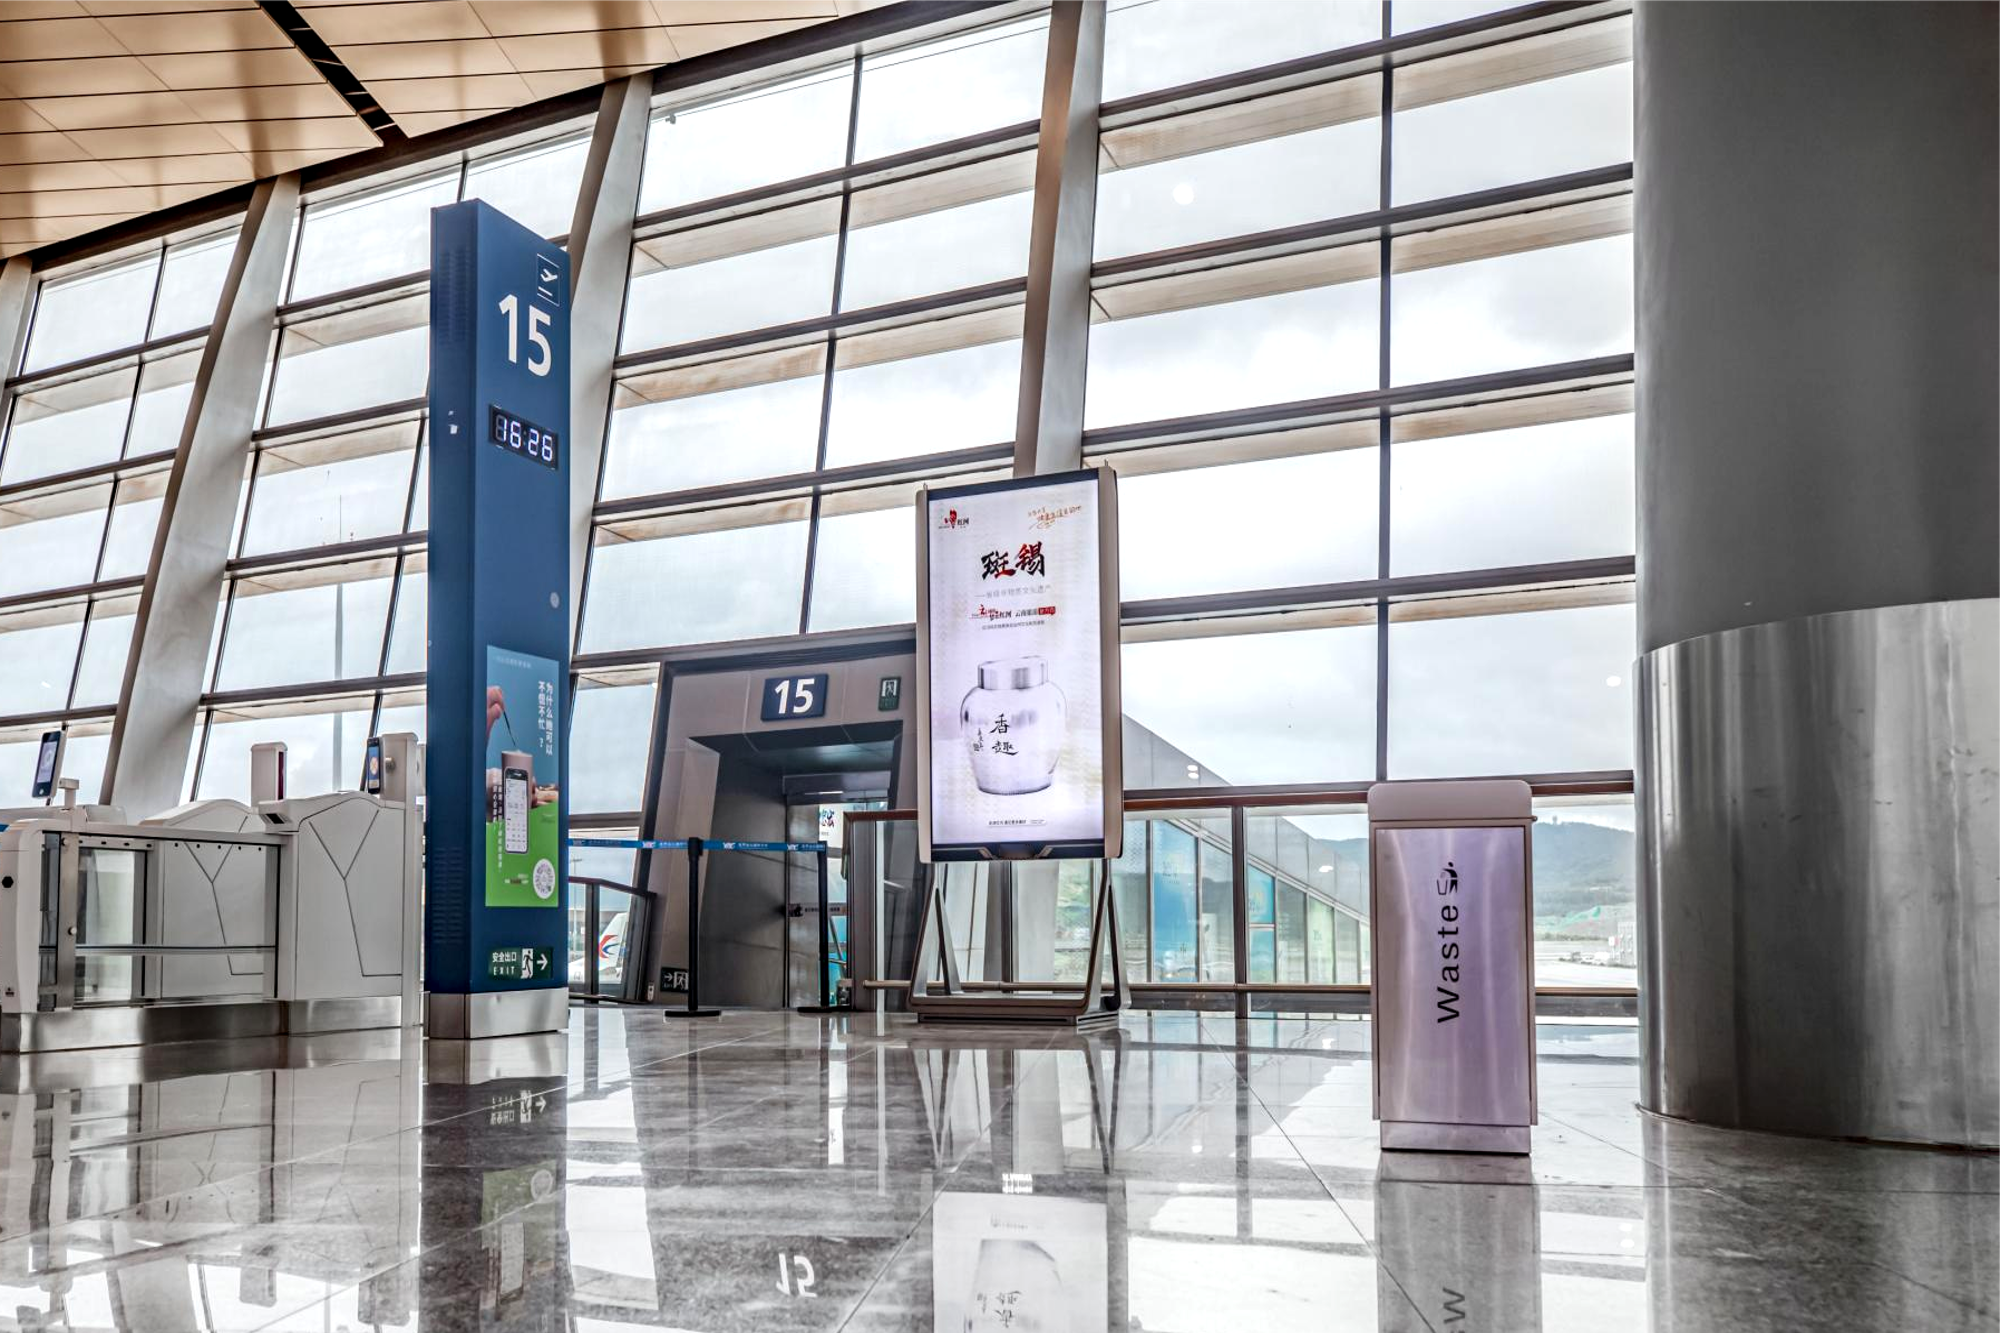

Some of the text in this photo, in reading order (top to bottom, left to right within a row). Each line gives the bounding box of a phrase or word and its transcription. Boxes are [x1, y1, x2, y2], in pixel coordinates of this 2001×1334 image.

[498, 294, 552, 377] 15
[502, 416, 553, 462] 16:26
[773, 678, 816, 715] 15
[492, 951, 517, 963] 安全出口
[493, 965, 515, 976] EXIT
[1437, 905, 1460, 1023] Waste
